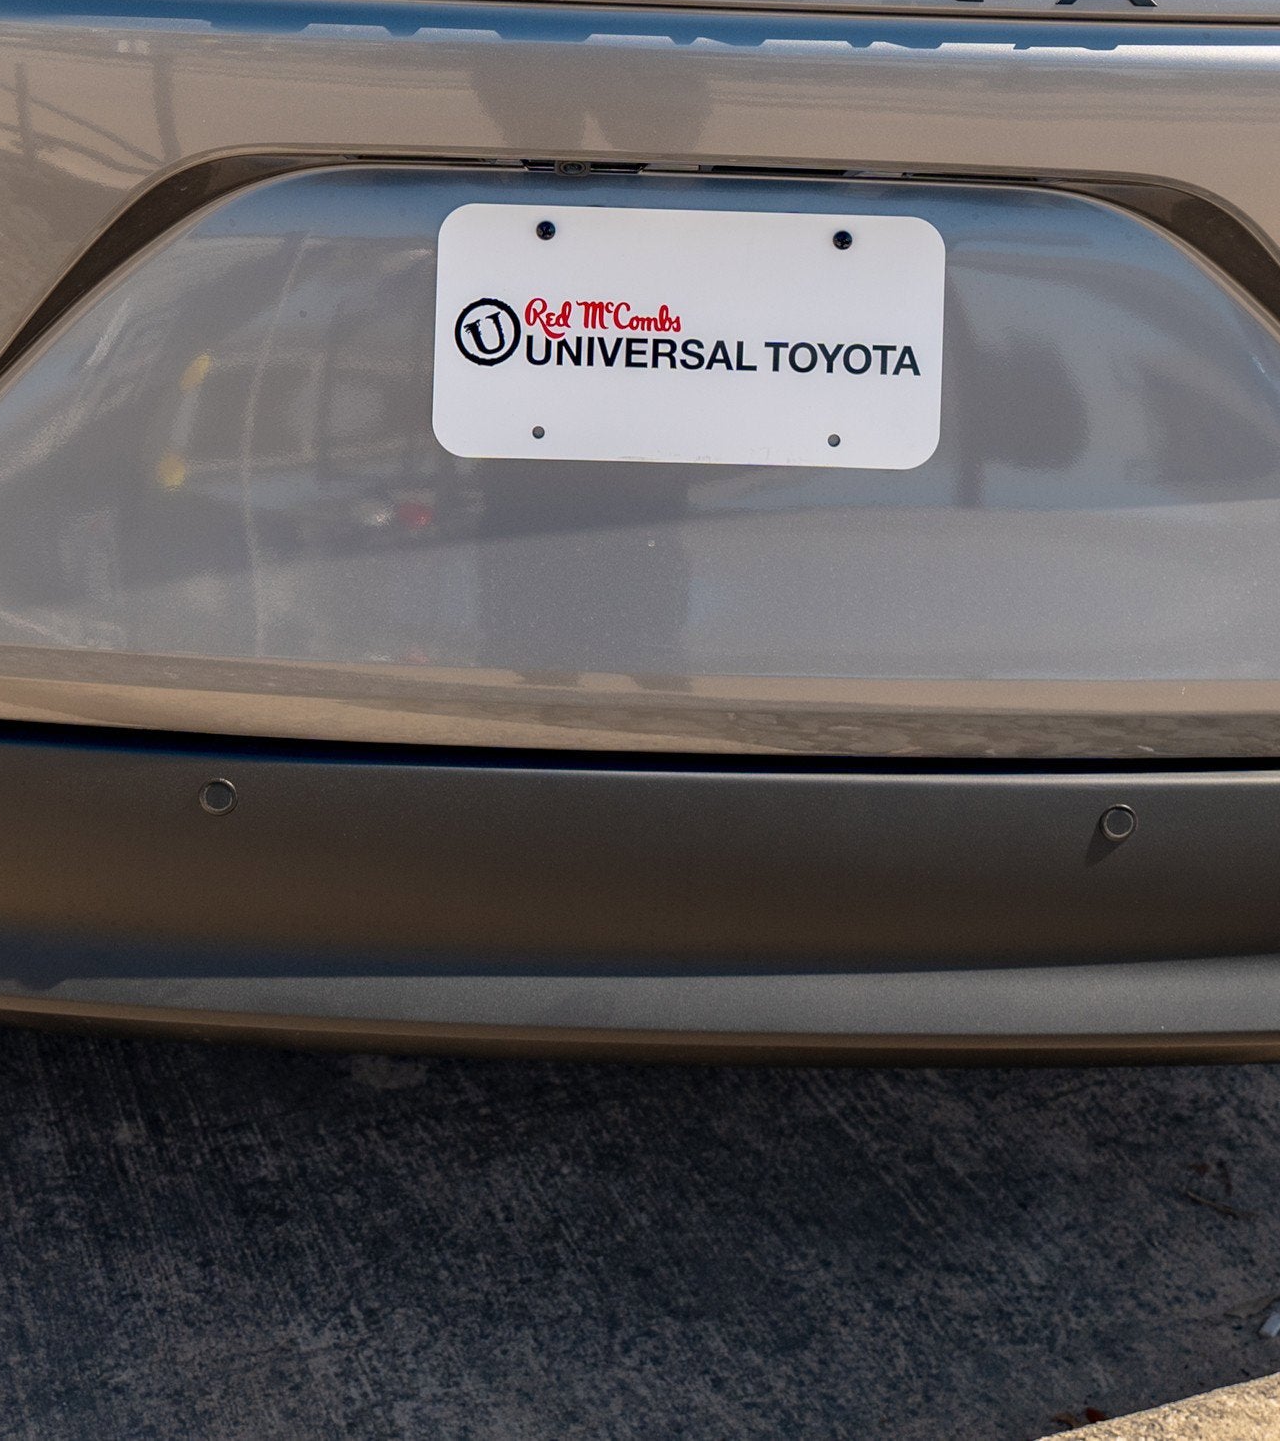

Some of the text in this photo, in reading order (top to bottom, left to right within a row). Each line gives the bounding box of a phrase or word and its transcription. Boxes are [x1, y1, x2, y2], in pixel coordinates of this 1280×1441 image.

[524, 297, 682, 339] Red McCombs
[525, 334, 921, 376] UNIVERSAL TOYOTA
